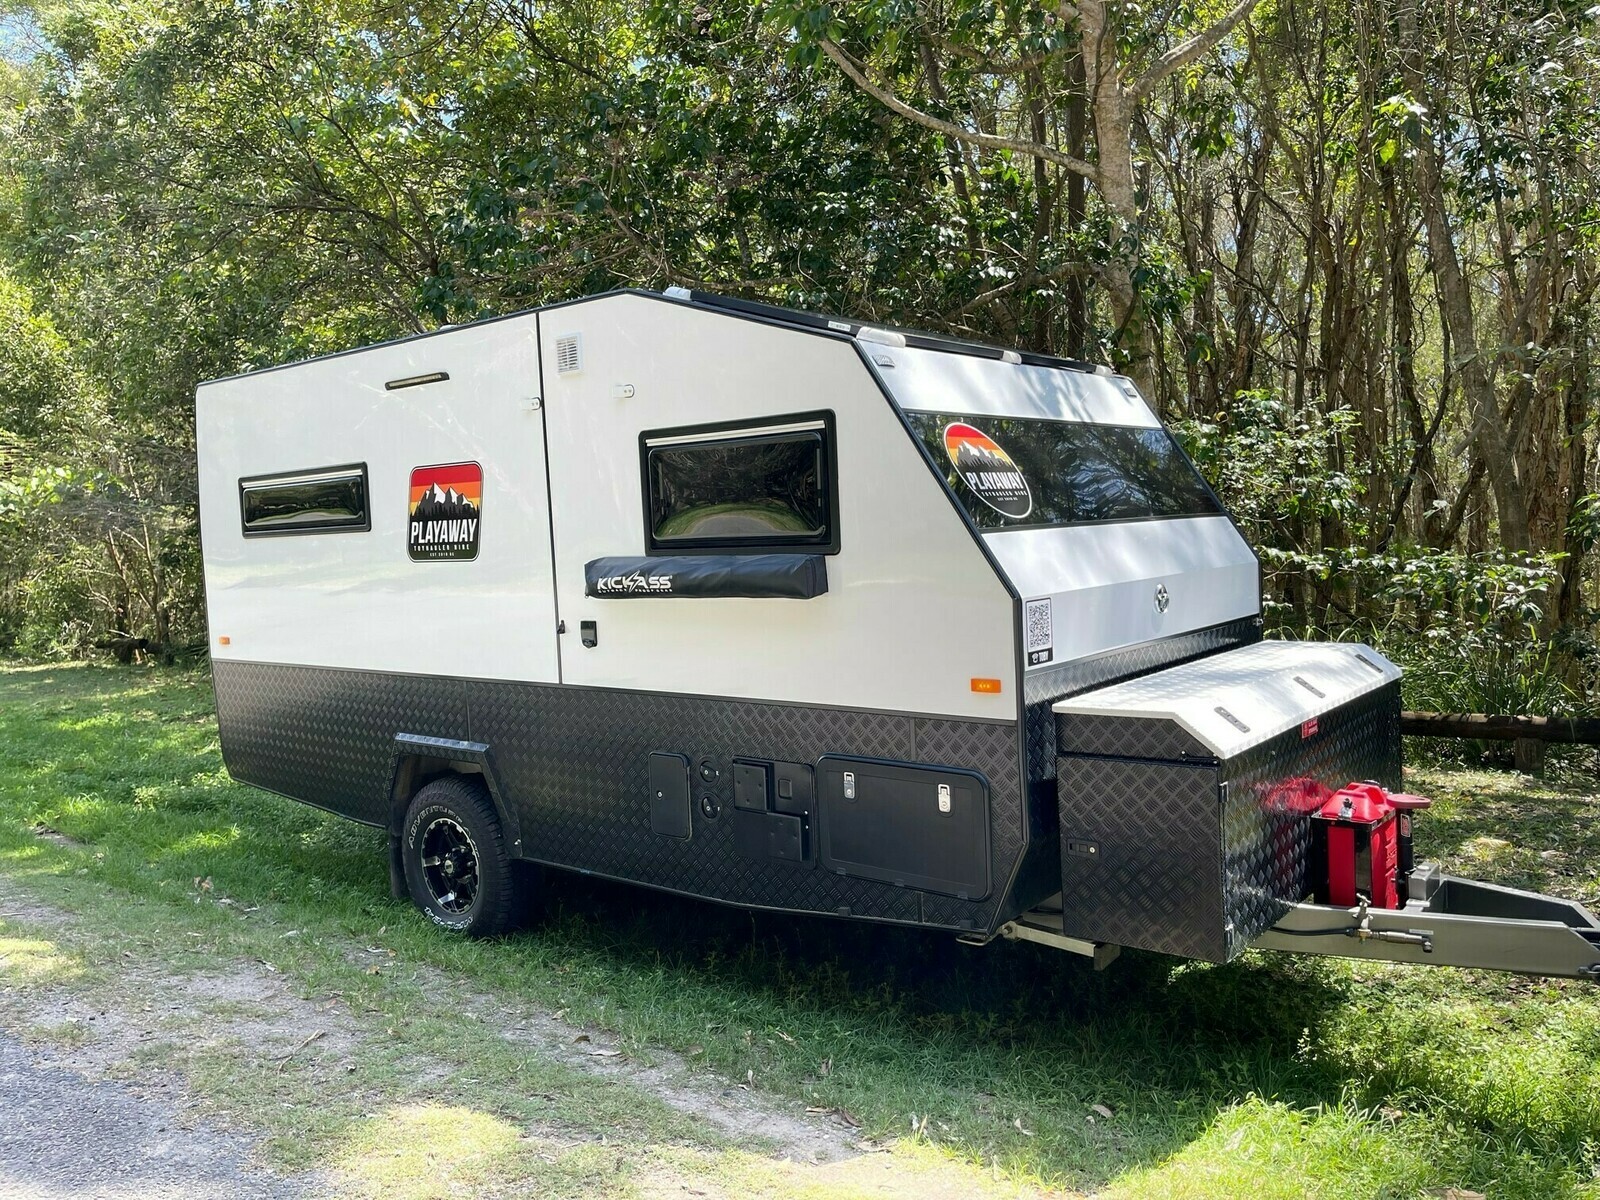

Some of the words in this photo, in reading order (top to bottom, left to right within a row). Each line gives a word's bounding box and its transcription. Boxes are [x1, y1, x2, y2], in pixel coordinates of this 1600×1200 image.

[965, 472, 1024, 490] PLAYAWAY
[411, 519, 477, 544] PLAYAWAY
[597, 575, 672, 590] KICKASS
